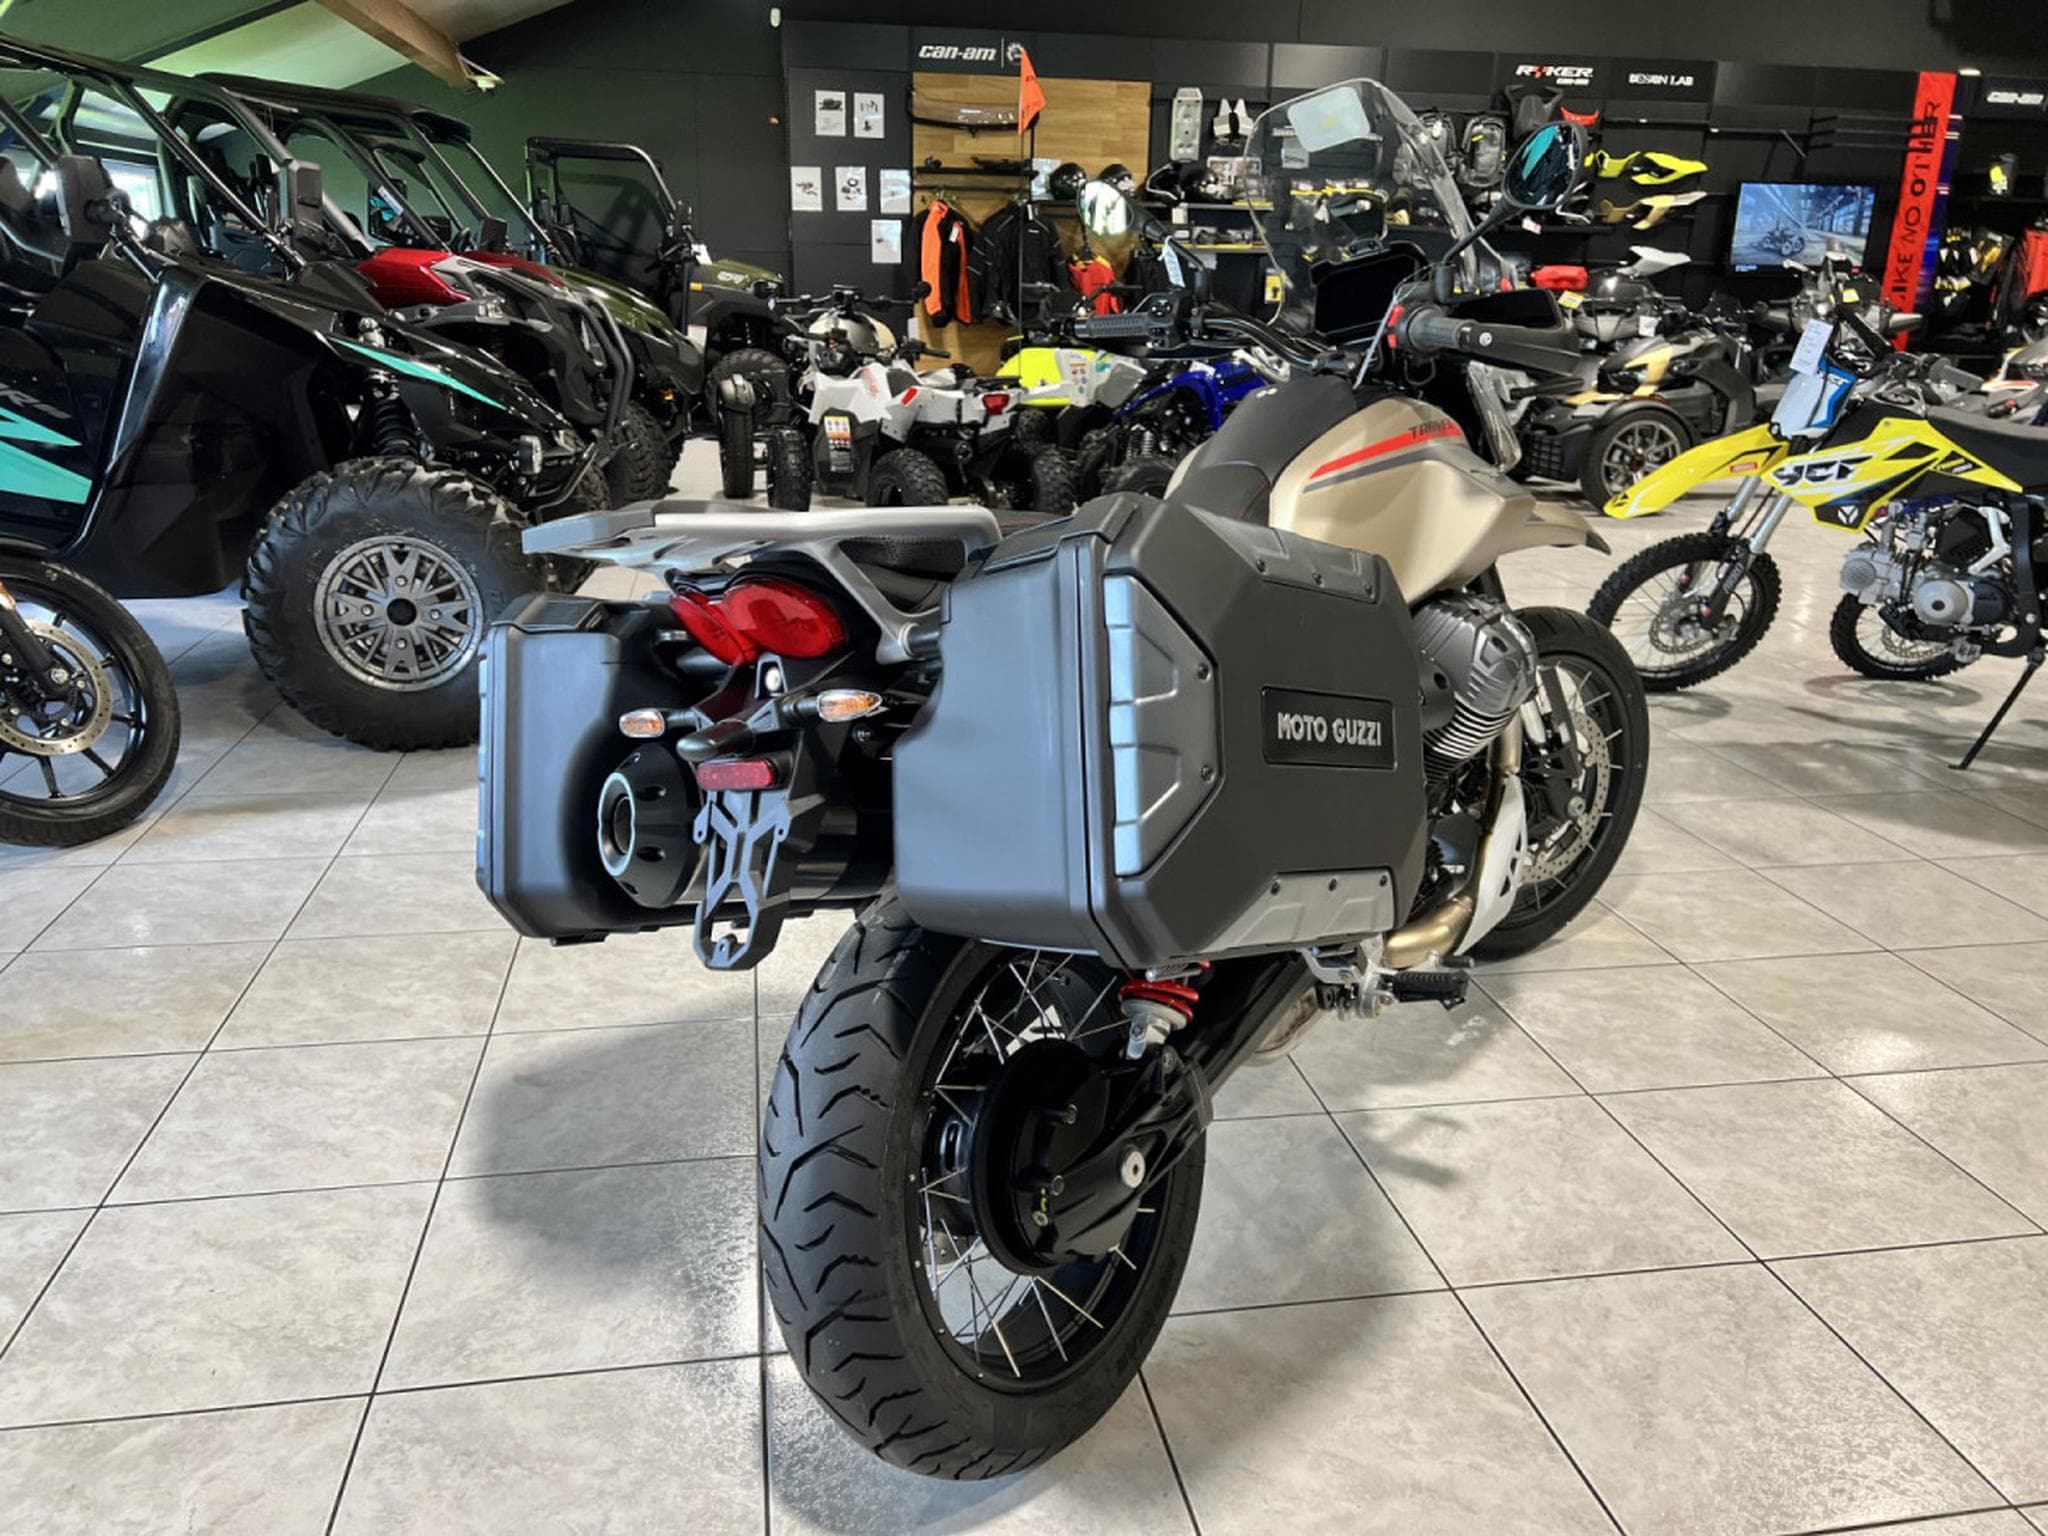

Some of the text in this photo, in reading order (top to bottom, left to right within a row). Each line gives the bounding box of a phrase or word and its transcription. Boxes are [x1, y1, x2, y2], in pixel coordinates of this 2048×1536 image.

[918, 45, 997, 61] can-am
[1669, 75, 1694, 86] LAB
[1903, 205, 1922, 244] NO
[1278, 712, 1381, 746] MOTO GUZZI
